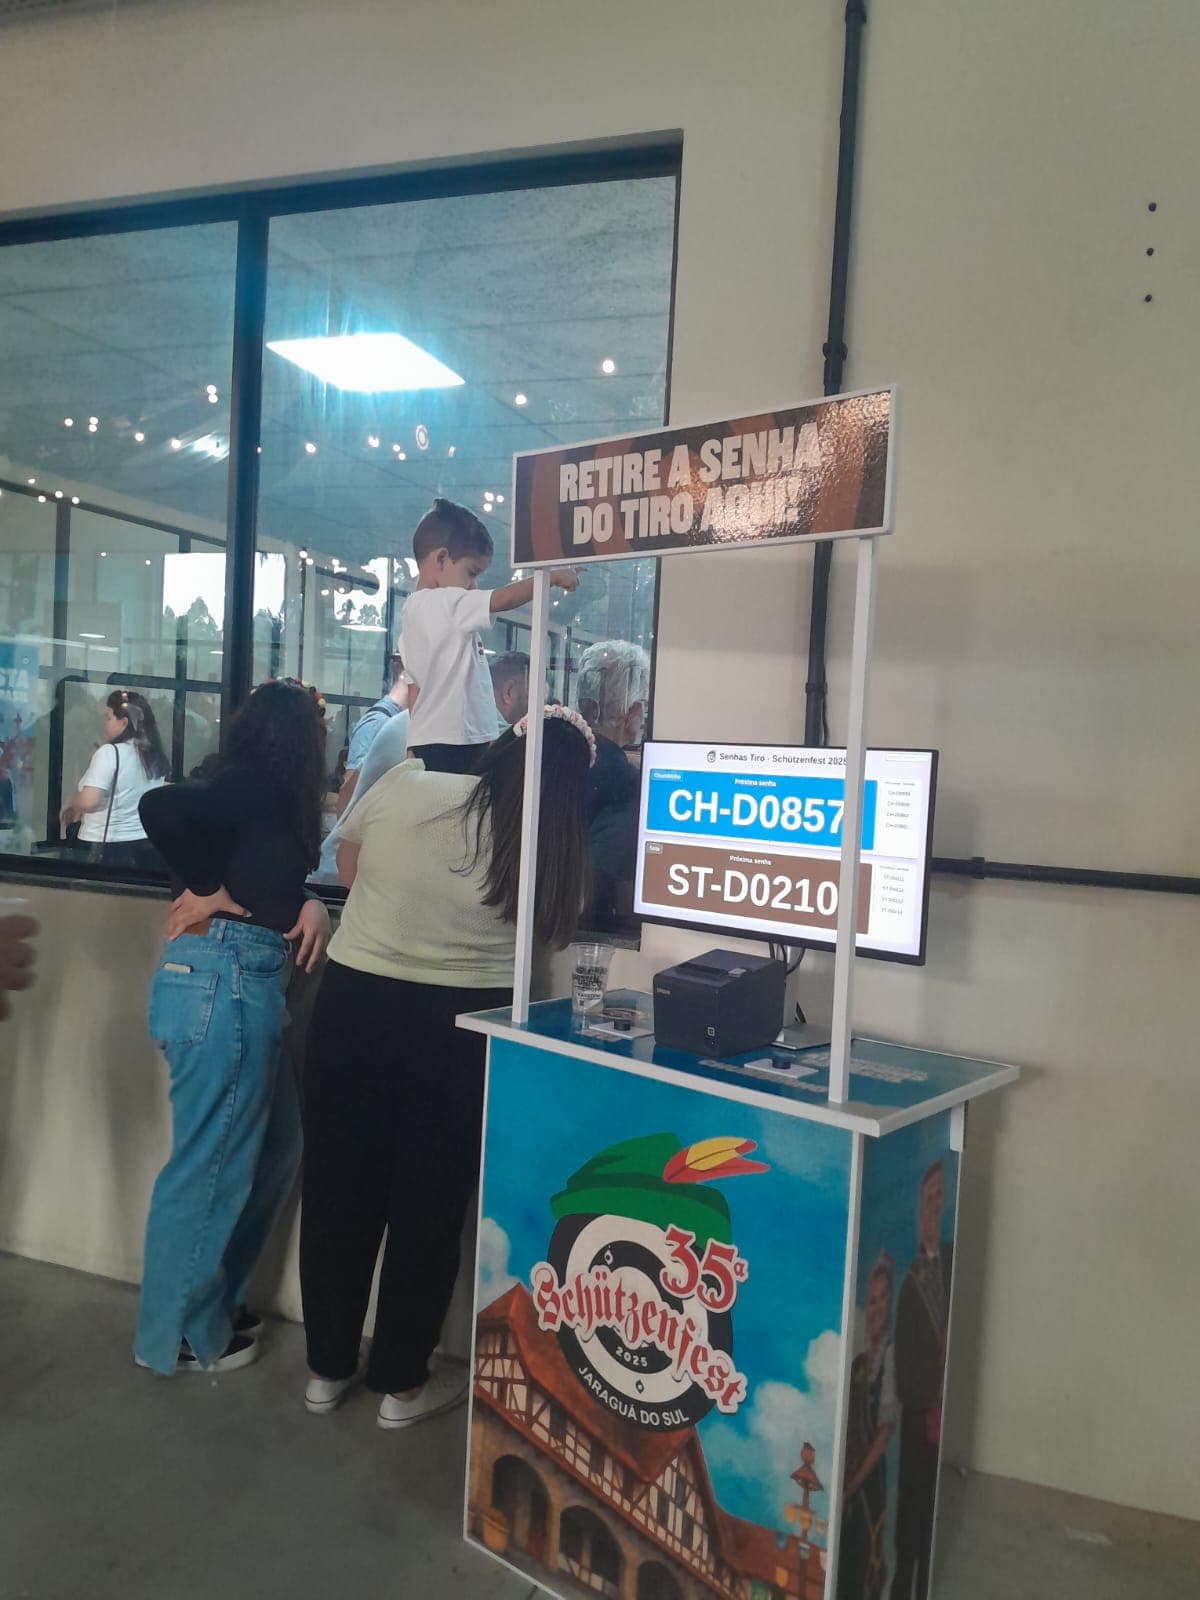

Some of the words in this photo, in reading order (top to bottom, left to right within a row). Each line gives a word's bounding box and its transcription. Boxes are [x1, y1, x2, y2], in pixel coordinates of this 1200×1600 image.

[560, 449, 663, 502] RETIRE
[668, 444, 691, 488] A
[700, 422, 822, 483] SENHA
[573, 502, 614, 545] DO
[621, 492, 694, 540] TIRO
[720, 752, 748, 761] Senhas
[750, 754, 765, 762] Tiro
[772, 754, 826, 765] Schützenfest
[669, 789, 845, 834] CH-D0857
[667, 863, 838, 915] ST-D0210
[535, 1267, 742, 1406] Schützenfest
[616, 1346, 648, 1367] 2025
[578, 1366, 637, 1421] JARAGUÁ
[640, 1409, 660, 1426] DO
[663, 1408, 690, 1426] SUL
